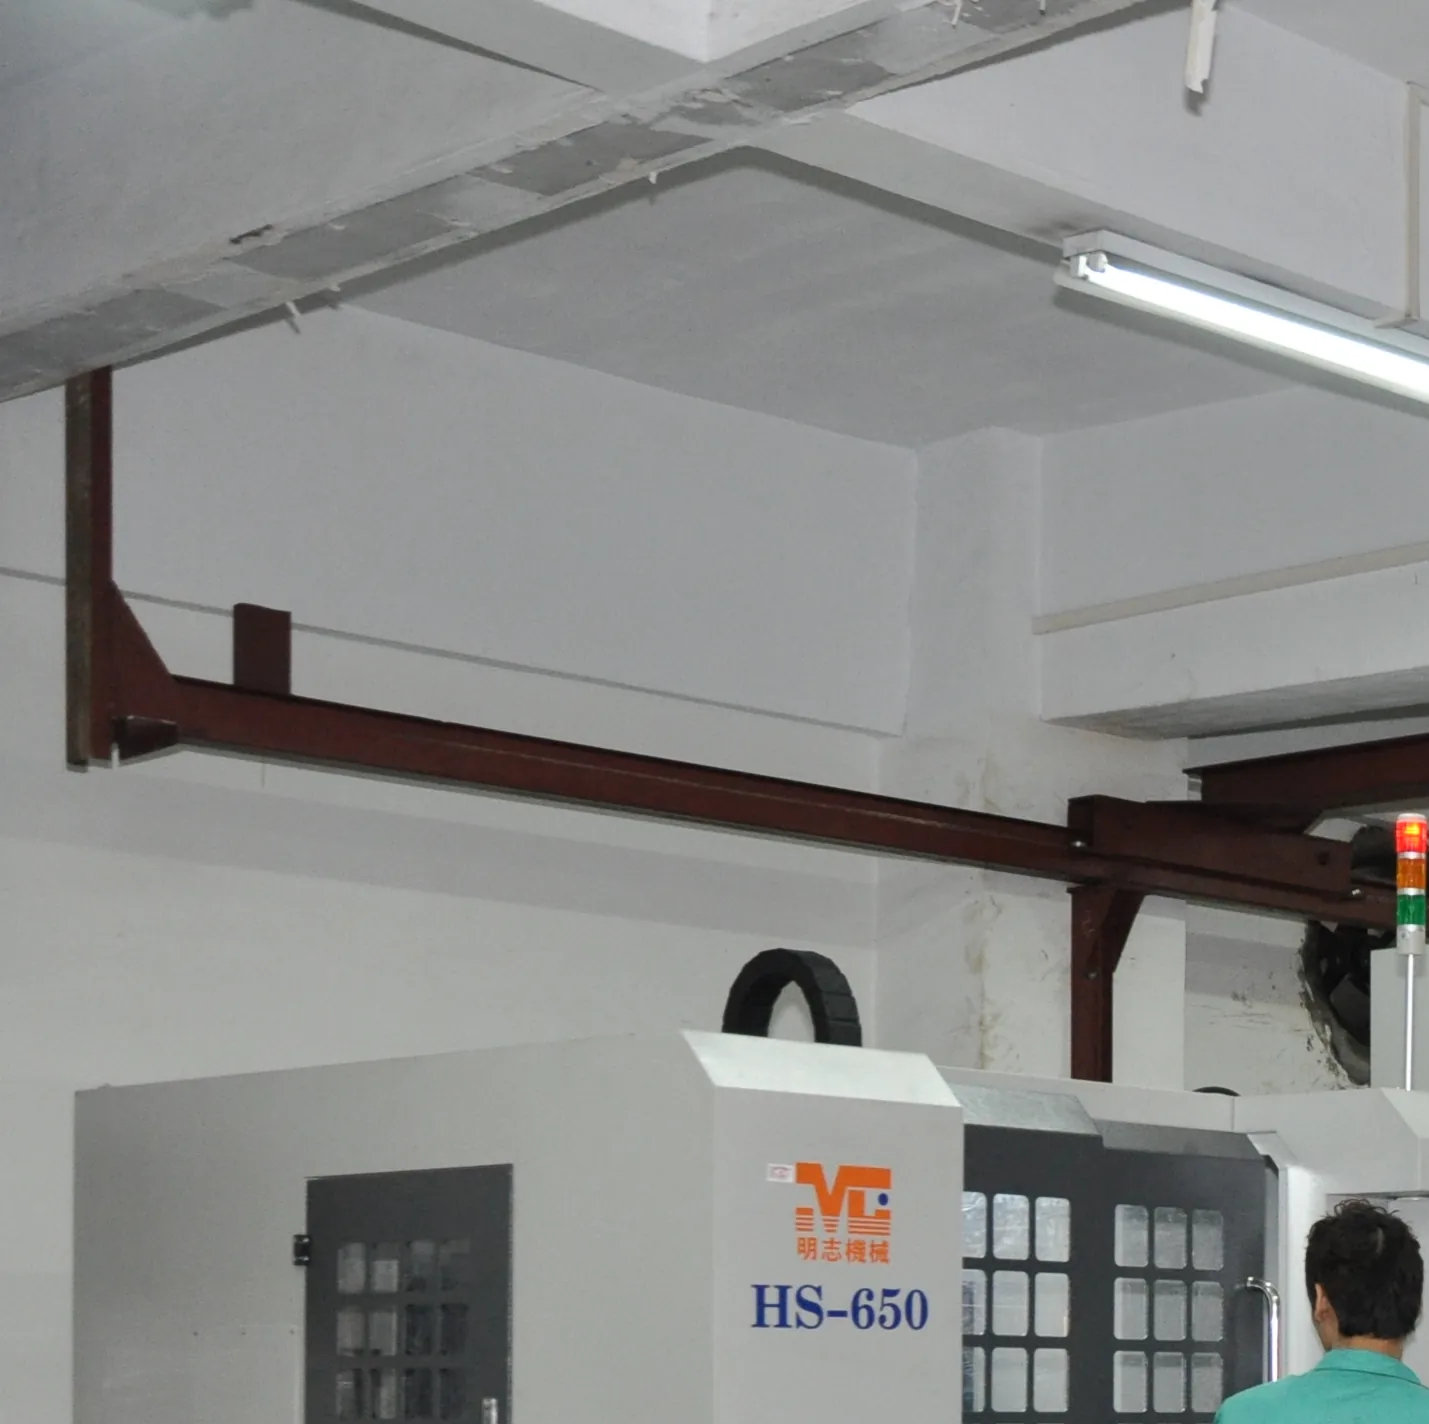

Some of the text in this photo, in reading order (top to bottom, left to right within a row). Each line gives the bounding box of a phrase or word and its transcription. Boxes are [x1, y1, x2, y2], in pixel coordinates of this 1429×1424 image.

[796, 1237, 890, 1264] 明志機械
[750, 1284, 928, 1330] HS-650
